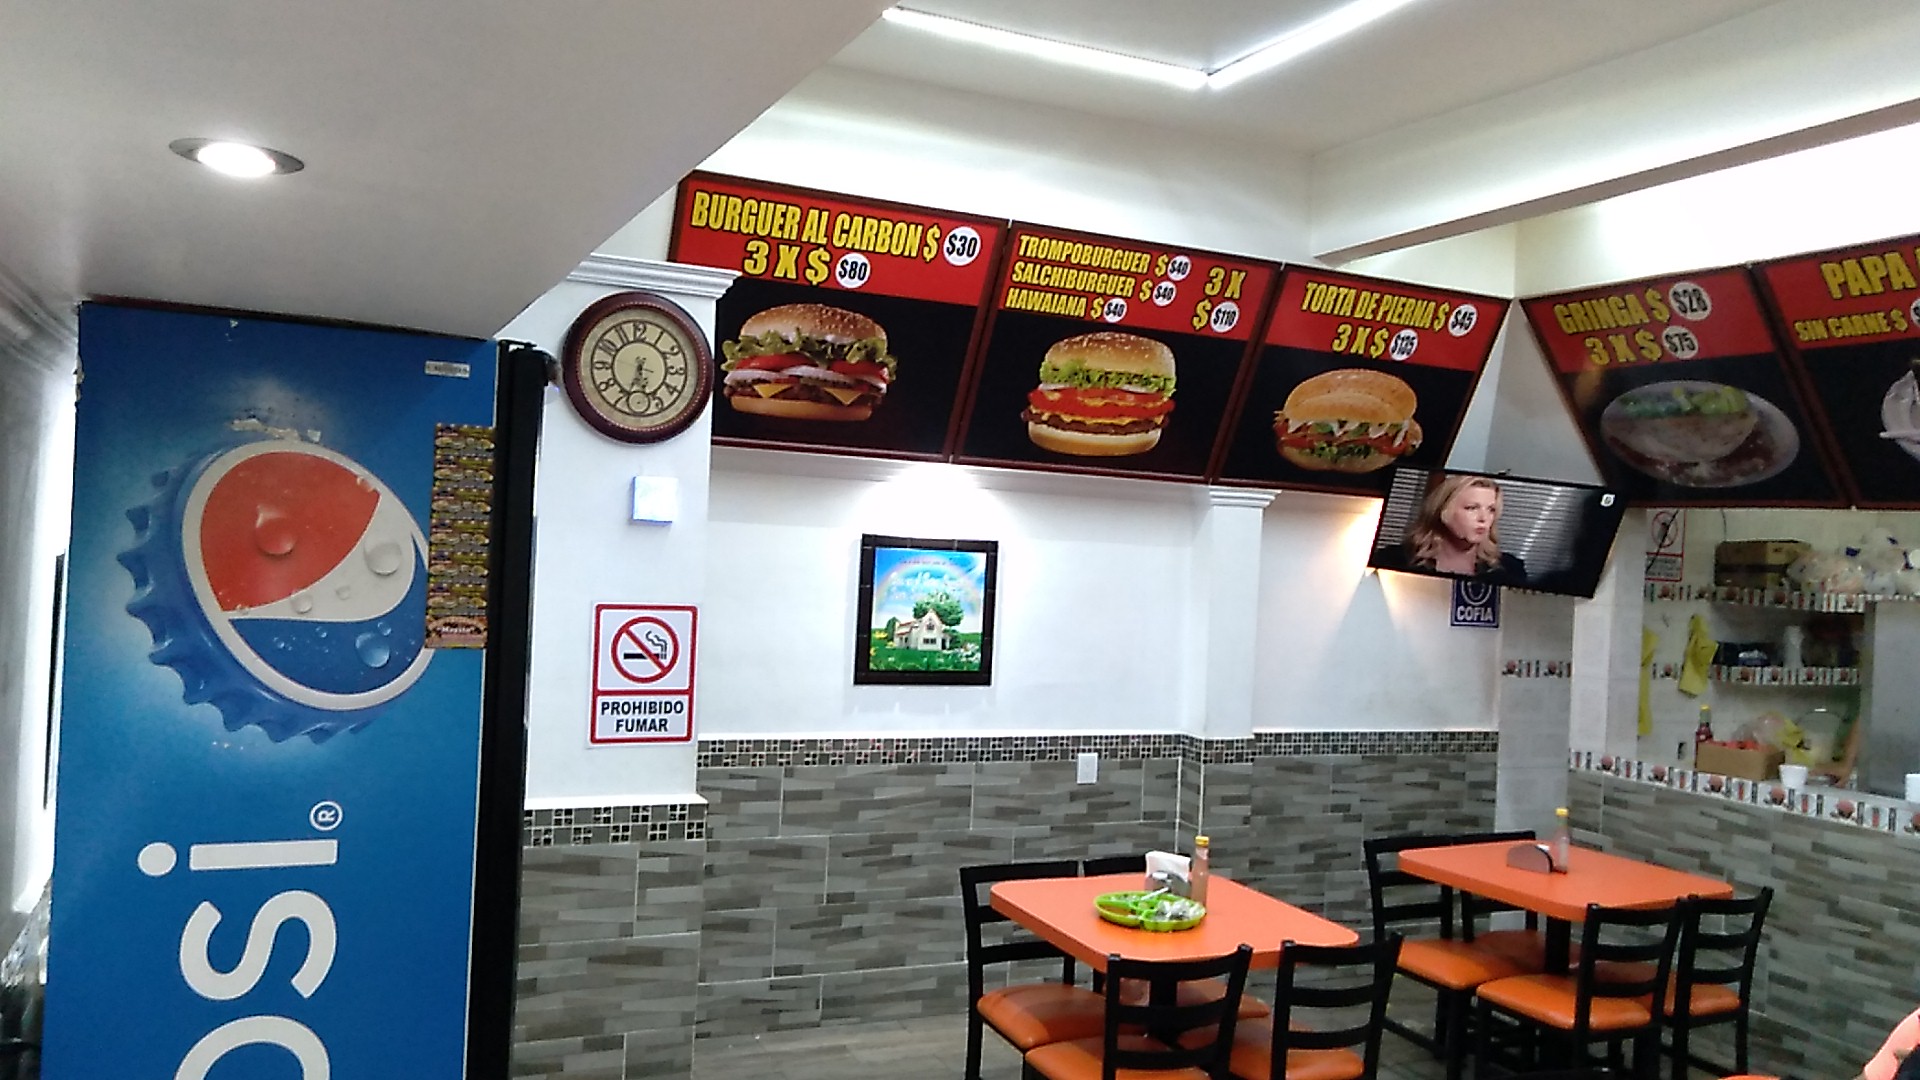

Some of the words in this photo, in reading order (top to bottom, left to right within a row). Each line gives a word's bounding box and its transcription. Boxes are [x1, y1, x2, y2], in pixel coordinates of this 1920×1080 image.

[691, 191, 801, 240] BURGUER
[801, 208, 830, 246] AL
[832, 213, 923, 258] CARBON
[922, 224, 941, 262] $
[946, 233, 978, 259] $30
[743, 240, 769, 276] 3
[774, 245, 801, 280] X
[805, 246, 832, 286] $
[838, 259, 868, 282] $80
[1018, 234, 1151, 275] TROMPOBURGUER
[1154, 253, 1169, 277] $
[1169, 259, 1189, 277] $40
[1011, 261, 1136, 297] SALCHIBURGUER
[1139, 279, 1154, 301] $
[1155, 284, 1174, 302] $40
[1204, 266, 1226, 297] 3
[1224, 270, 1247, 300] X
[1821, 251, 1917, 299] PAPA
[1005, 287, 1087, 318] HAWAIANA
[1090, 297, 1104, 319] $
[1105, 301, 1124, 318] $40
[1192, 298, 1212, 330] $
[1213, 307, 1237, 327] $110
[1302, 281, 1357, 317] TORTA
[1354, 291, 1380, 320] DE
[1376, 294, 1436, 329] PIERNA
[1433, 301, 1450, 332] $
[1451, 308, 1475, 331] $45
[1553, 293, 1649, 335] GRINGA
[1644, 288, 1672, 324] $
[1331, 323, 1352, 352] 3
[1350, 326, 1372, 355] X
[1370, 326, 1389, 359] $
[1794, 319, 1829, 342] SIN
[1827, 311, 1891, 339] CARNE
[1584, 336, 1611, 366] 3
[1608, 332, 1636, 363] X
[1635, 329, 1664, 361] $
[1665, 332, 1696, 353] $75
[1457, 605, 1494, 622] COFIA
[601, 700, 684, 716] PROHIBIDO
[615, 718, 669, 733] FUMAR
